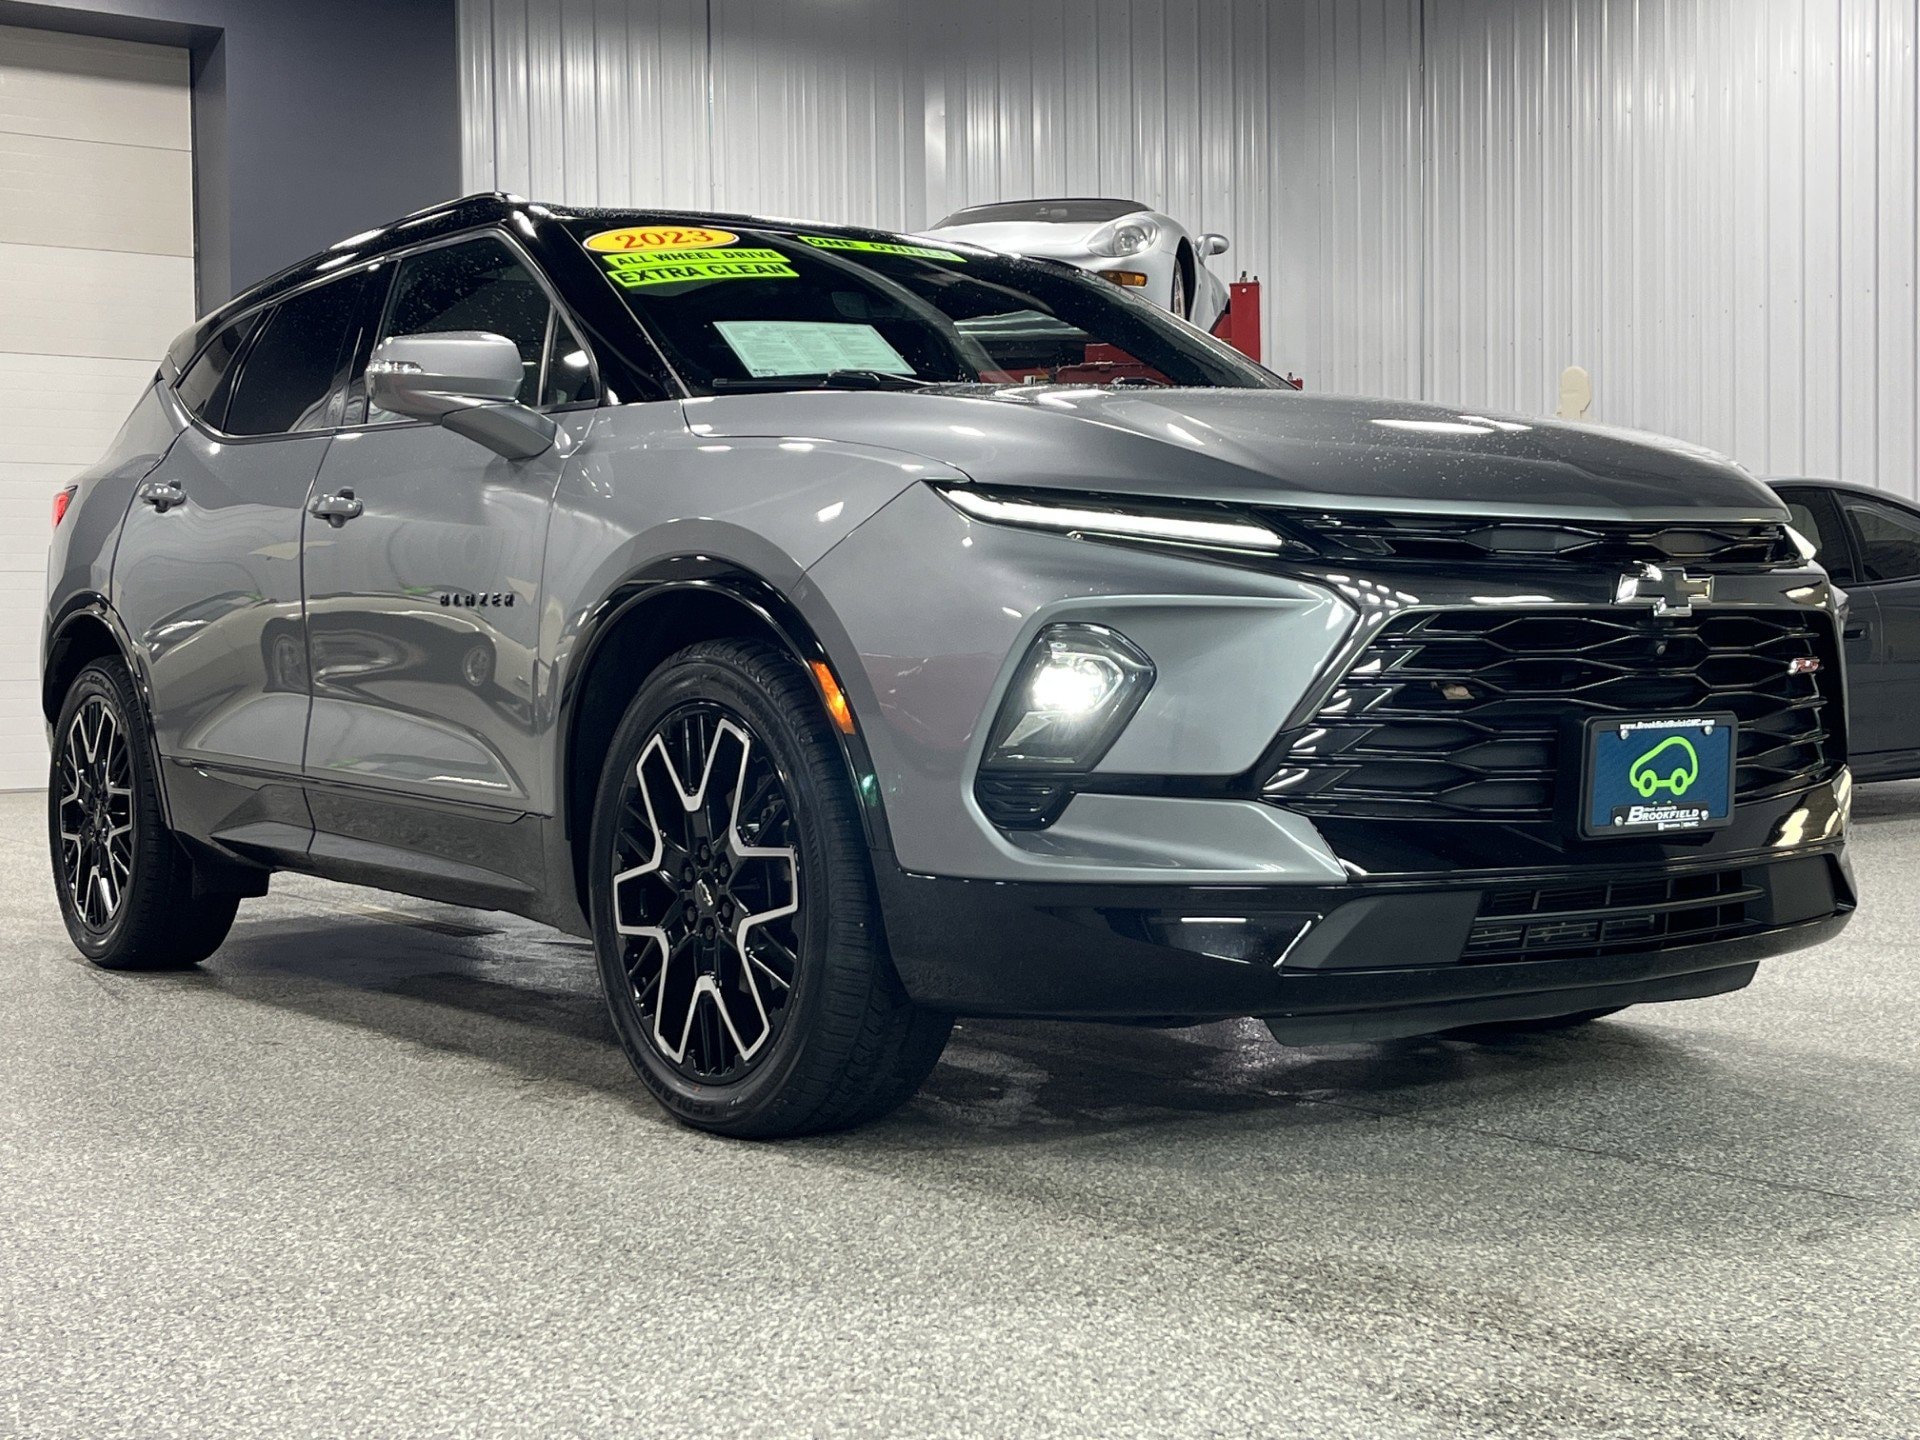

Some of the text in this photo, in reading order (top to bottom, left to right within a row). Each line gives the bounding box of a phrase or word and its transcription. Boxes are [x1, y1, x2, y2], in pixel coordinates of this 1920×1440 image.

[615, 230, 713, 249] 2023
[807, 237, 956, 259] ONE OWNER
[616, 250, 780, 266] ALL WHEEL DRIVE
[617, 263, 788, 284] EXTRA CLEAN
[440, 592, 515, 607] BLAZER
[1627, 805, 1700, 822] BROOKFIELD
